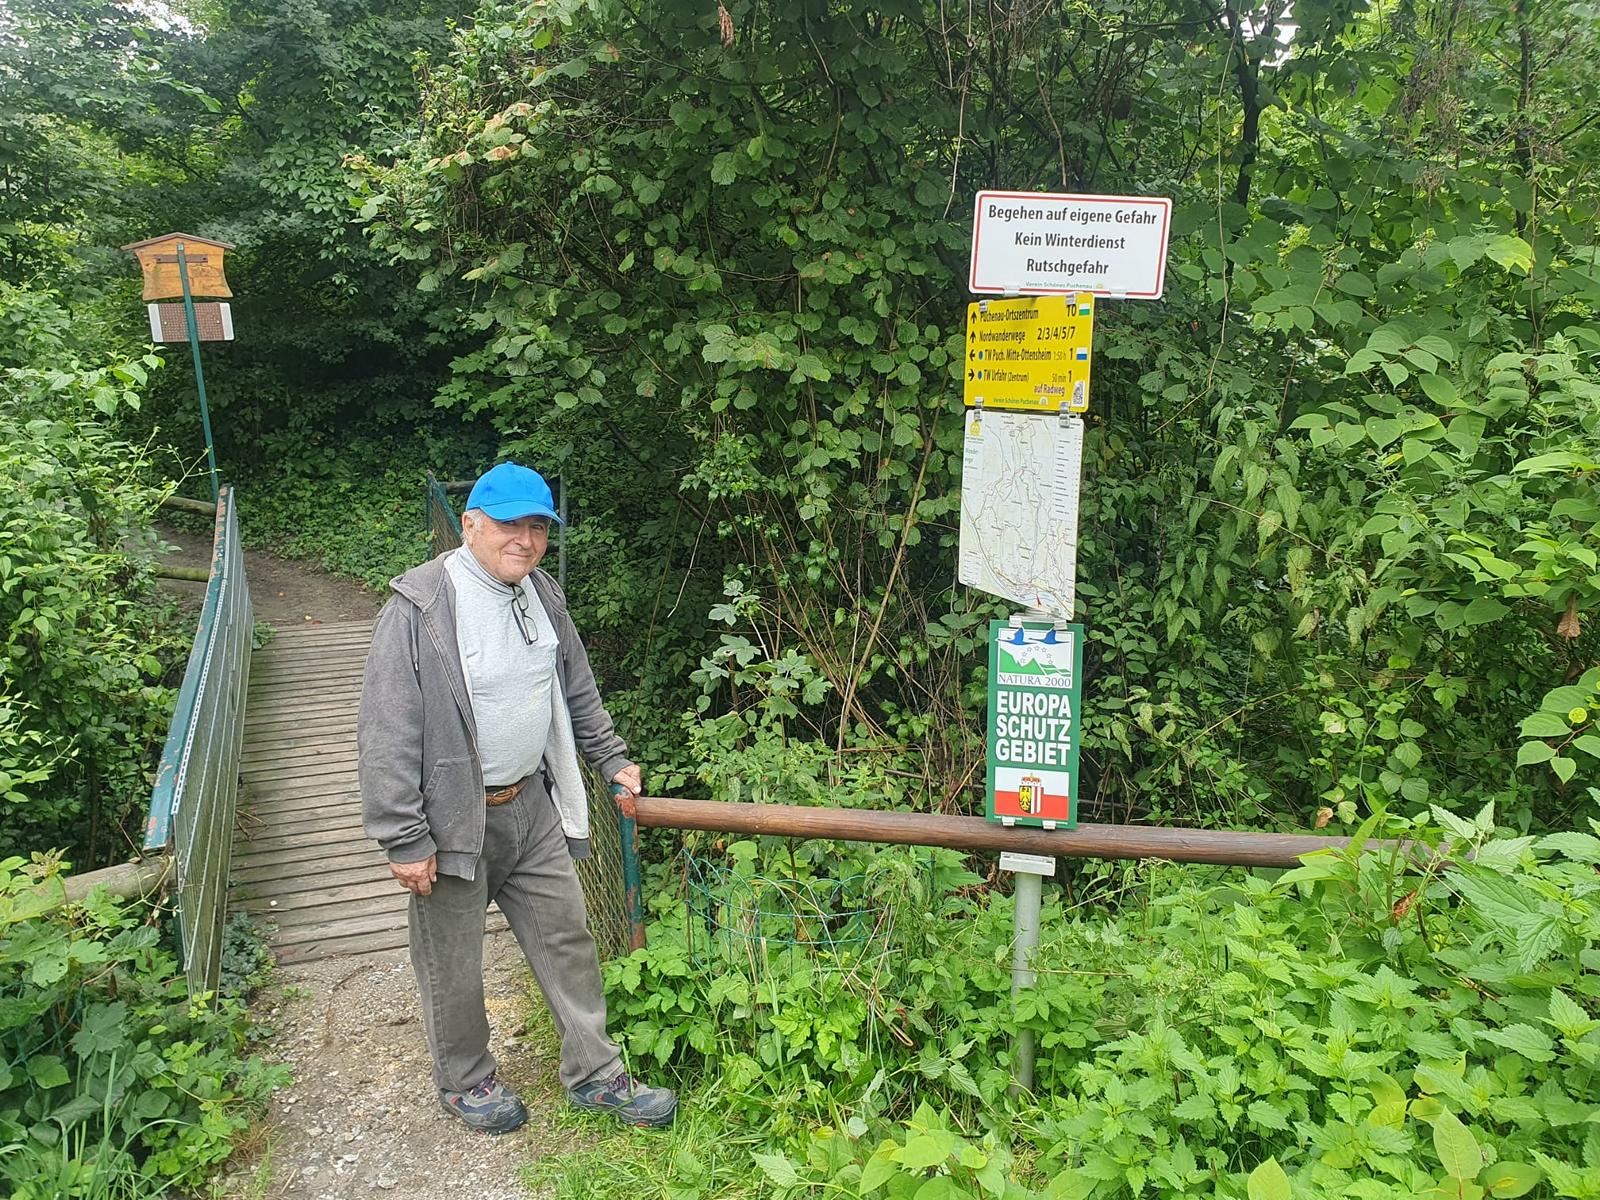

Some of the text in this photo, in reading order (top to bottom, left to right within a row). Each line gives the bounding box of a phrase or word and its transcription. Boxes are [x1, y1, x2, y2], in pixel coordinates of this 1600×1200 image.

[988, 204, 1157, 225] Begehen auf eigene Gefahr
[1015, 232, 1126, 249] Kein Winterdienst
[1026, 258, 1109, 276] Rutschgefahr
[979, 326, 1076, 344] Nordwanderwege 2/3/4/5/7
[1043, 384, 1065, 396] Radweg
[998, 674, 1071, 687] NATURA 2000
[996, 690, 1072, 718] EUROPA
[995, 714, 1071, 741] SCHUTZ
[995, 738, 1071, 766] GEBIET
